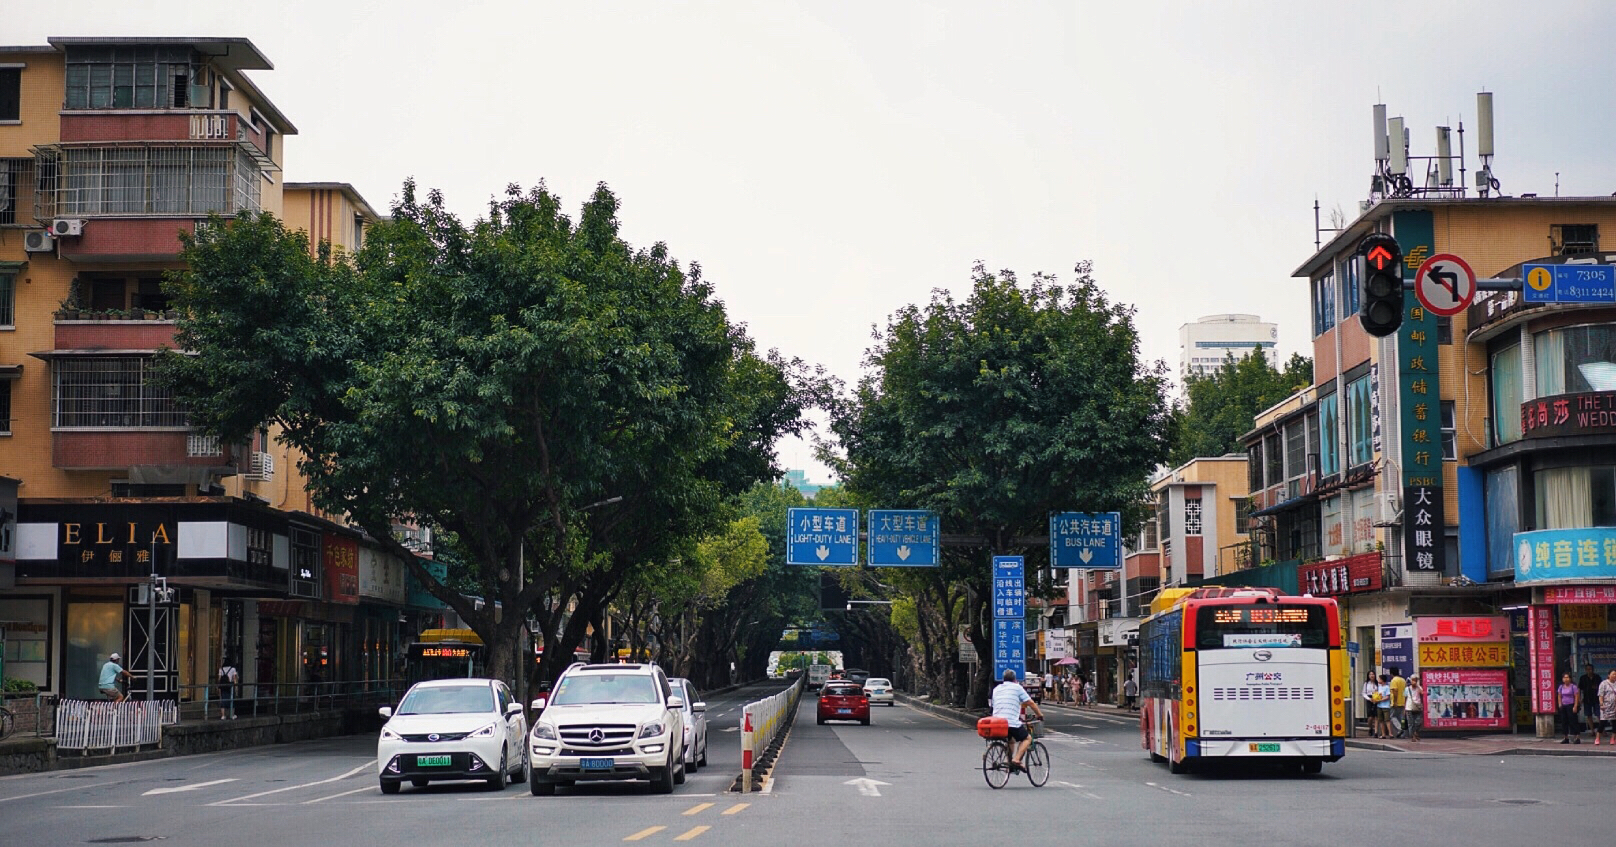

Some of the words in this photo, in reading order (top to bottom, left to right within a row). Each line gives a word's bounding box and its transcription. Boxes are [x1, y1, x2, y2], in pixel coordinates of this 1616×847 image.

[1576, 270, 1606, 281] 7305
[1569, 285, 1590, 298] 8311
[1591, 288, 1614, 298] 2424
[1411, 288, 1430, 466] 国邮政储蓄银行
[1577, 395, 1601, 410] THE
[1409, 477, 1437, 487] PSBC
[800, 514, 847, 533] 小型车道
[880, 514, 927, 532] 大型车道
[1059, 518, 1112, 536] 公共汽车道
[1414, 487, 1435, 570] 大众眼镜
[63, 521, 171, 545] ELIA
[794, 533, 832, 544] LIGHT-DUTY
[834, 534, 852, 544] LANE
[902, 534, 919, 544] VEHICLE
[920, 534, 931, 543] LANE
[1065, 537, 1082, 547] BUS
[1083, 537, 1106, 547] LANE
[996, 579, 1022, 588] 沿线出
[997, 588, 1022, 597] 入车辆
[996, 597, 1022, 606] 可临时
[998, 621, 1007, 658] 南华东路
[1011, 621, 1021, 658] 滨江路
[1423, 646, 1499, 662] 大众眼镜公司
[1245, 672, 1282, 681] 广州公交
